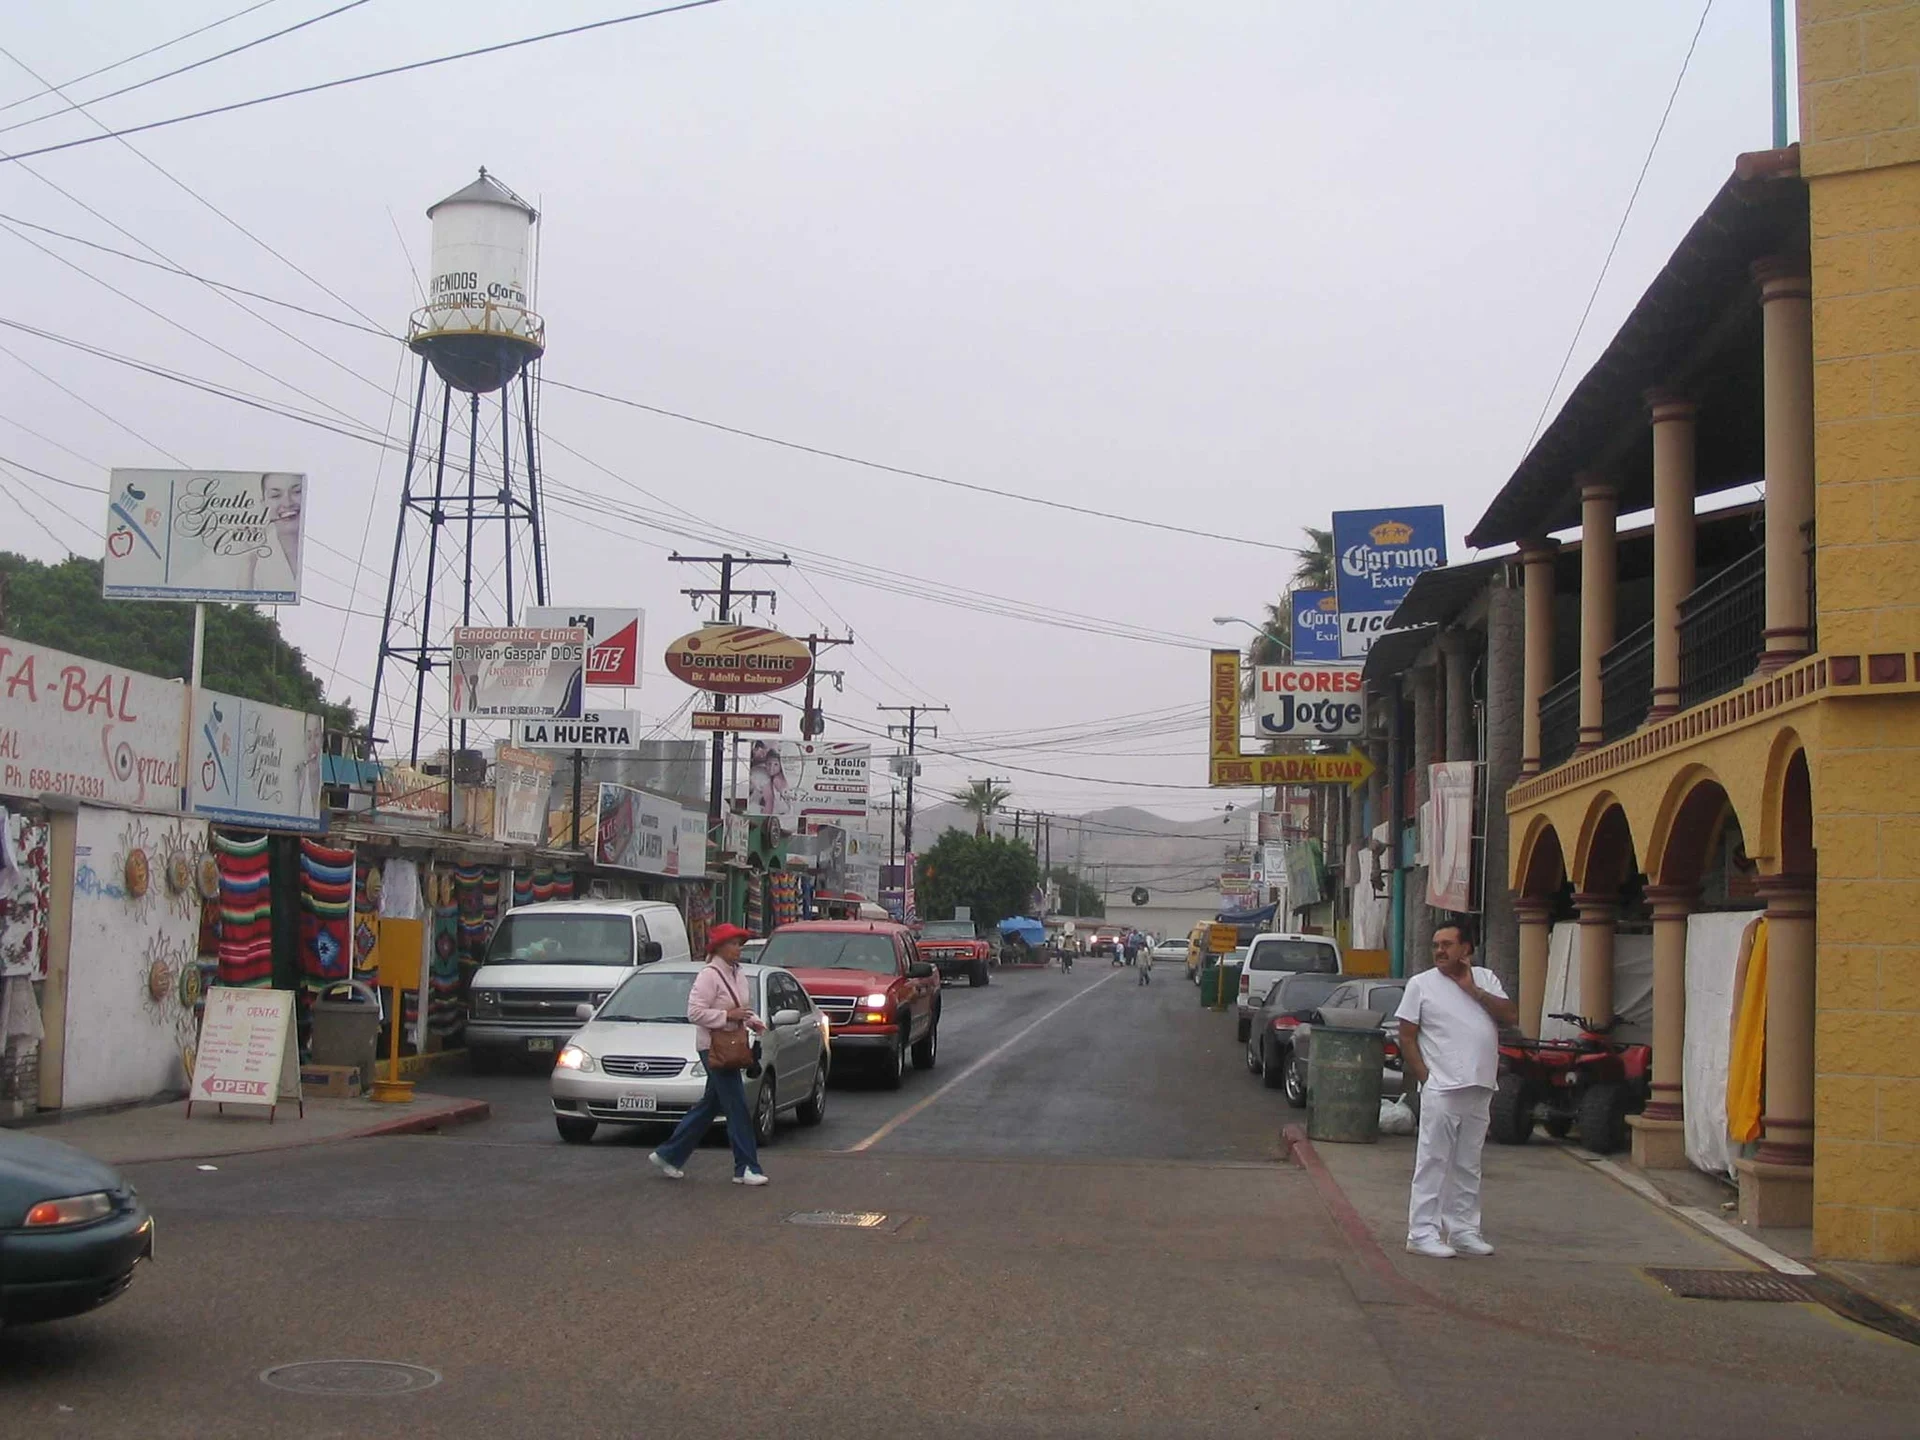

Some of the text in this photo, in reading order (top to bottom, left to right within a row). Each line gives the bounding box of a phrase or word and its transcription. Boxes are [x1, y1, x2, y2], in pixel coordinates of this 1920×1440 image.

[177, 477, 254, 516] Gentle
[174, 507, 269, 537] Dental
[202, 528, 272, 558] Care
[1342, 544, 1438, 579] Corona
[459, 628, 578, 640] Endodontic Clinic
[475, 647, 500, 660] Ivan
[504, 647, 547, 662] Gaspar
[682, 652, 794, 670] Dental Clinic
[692, 672, 783, 684] Dr. Adolfo Cabrera
[1262, 671, 1362, 692] LICORES
[1215, 662, 1235, 756] CERVEZA
[1261, 694, 1362, 733] Jorge
[524, 726, 630, 744] LA HUERTA
[817, 758, 866, 768] Dr. Adolfo
[822, 767, 861, 776] Cabrera
[1260, 760, 1316, 781] PARA
[213, 1080, 258, 1093] OPEN
